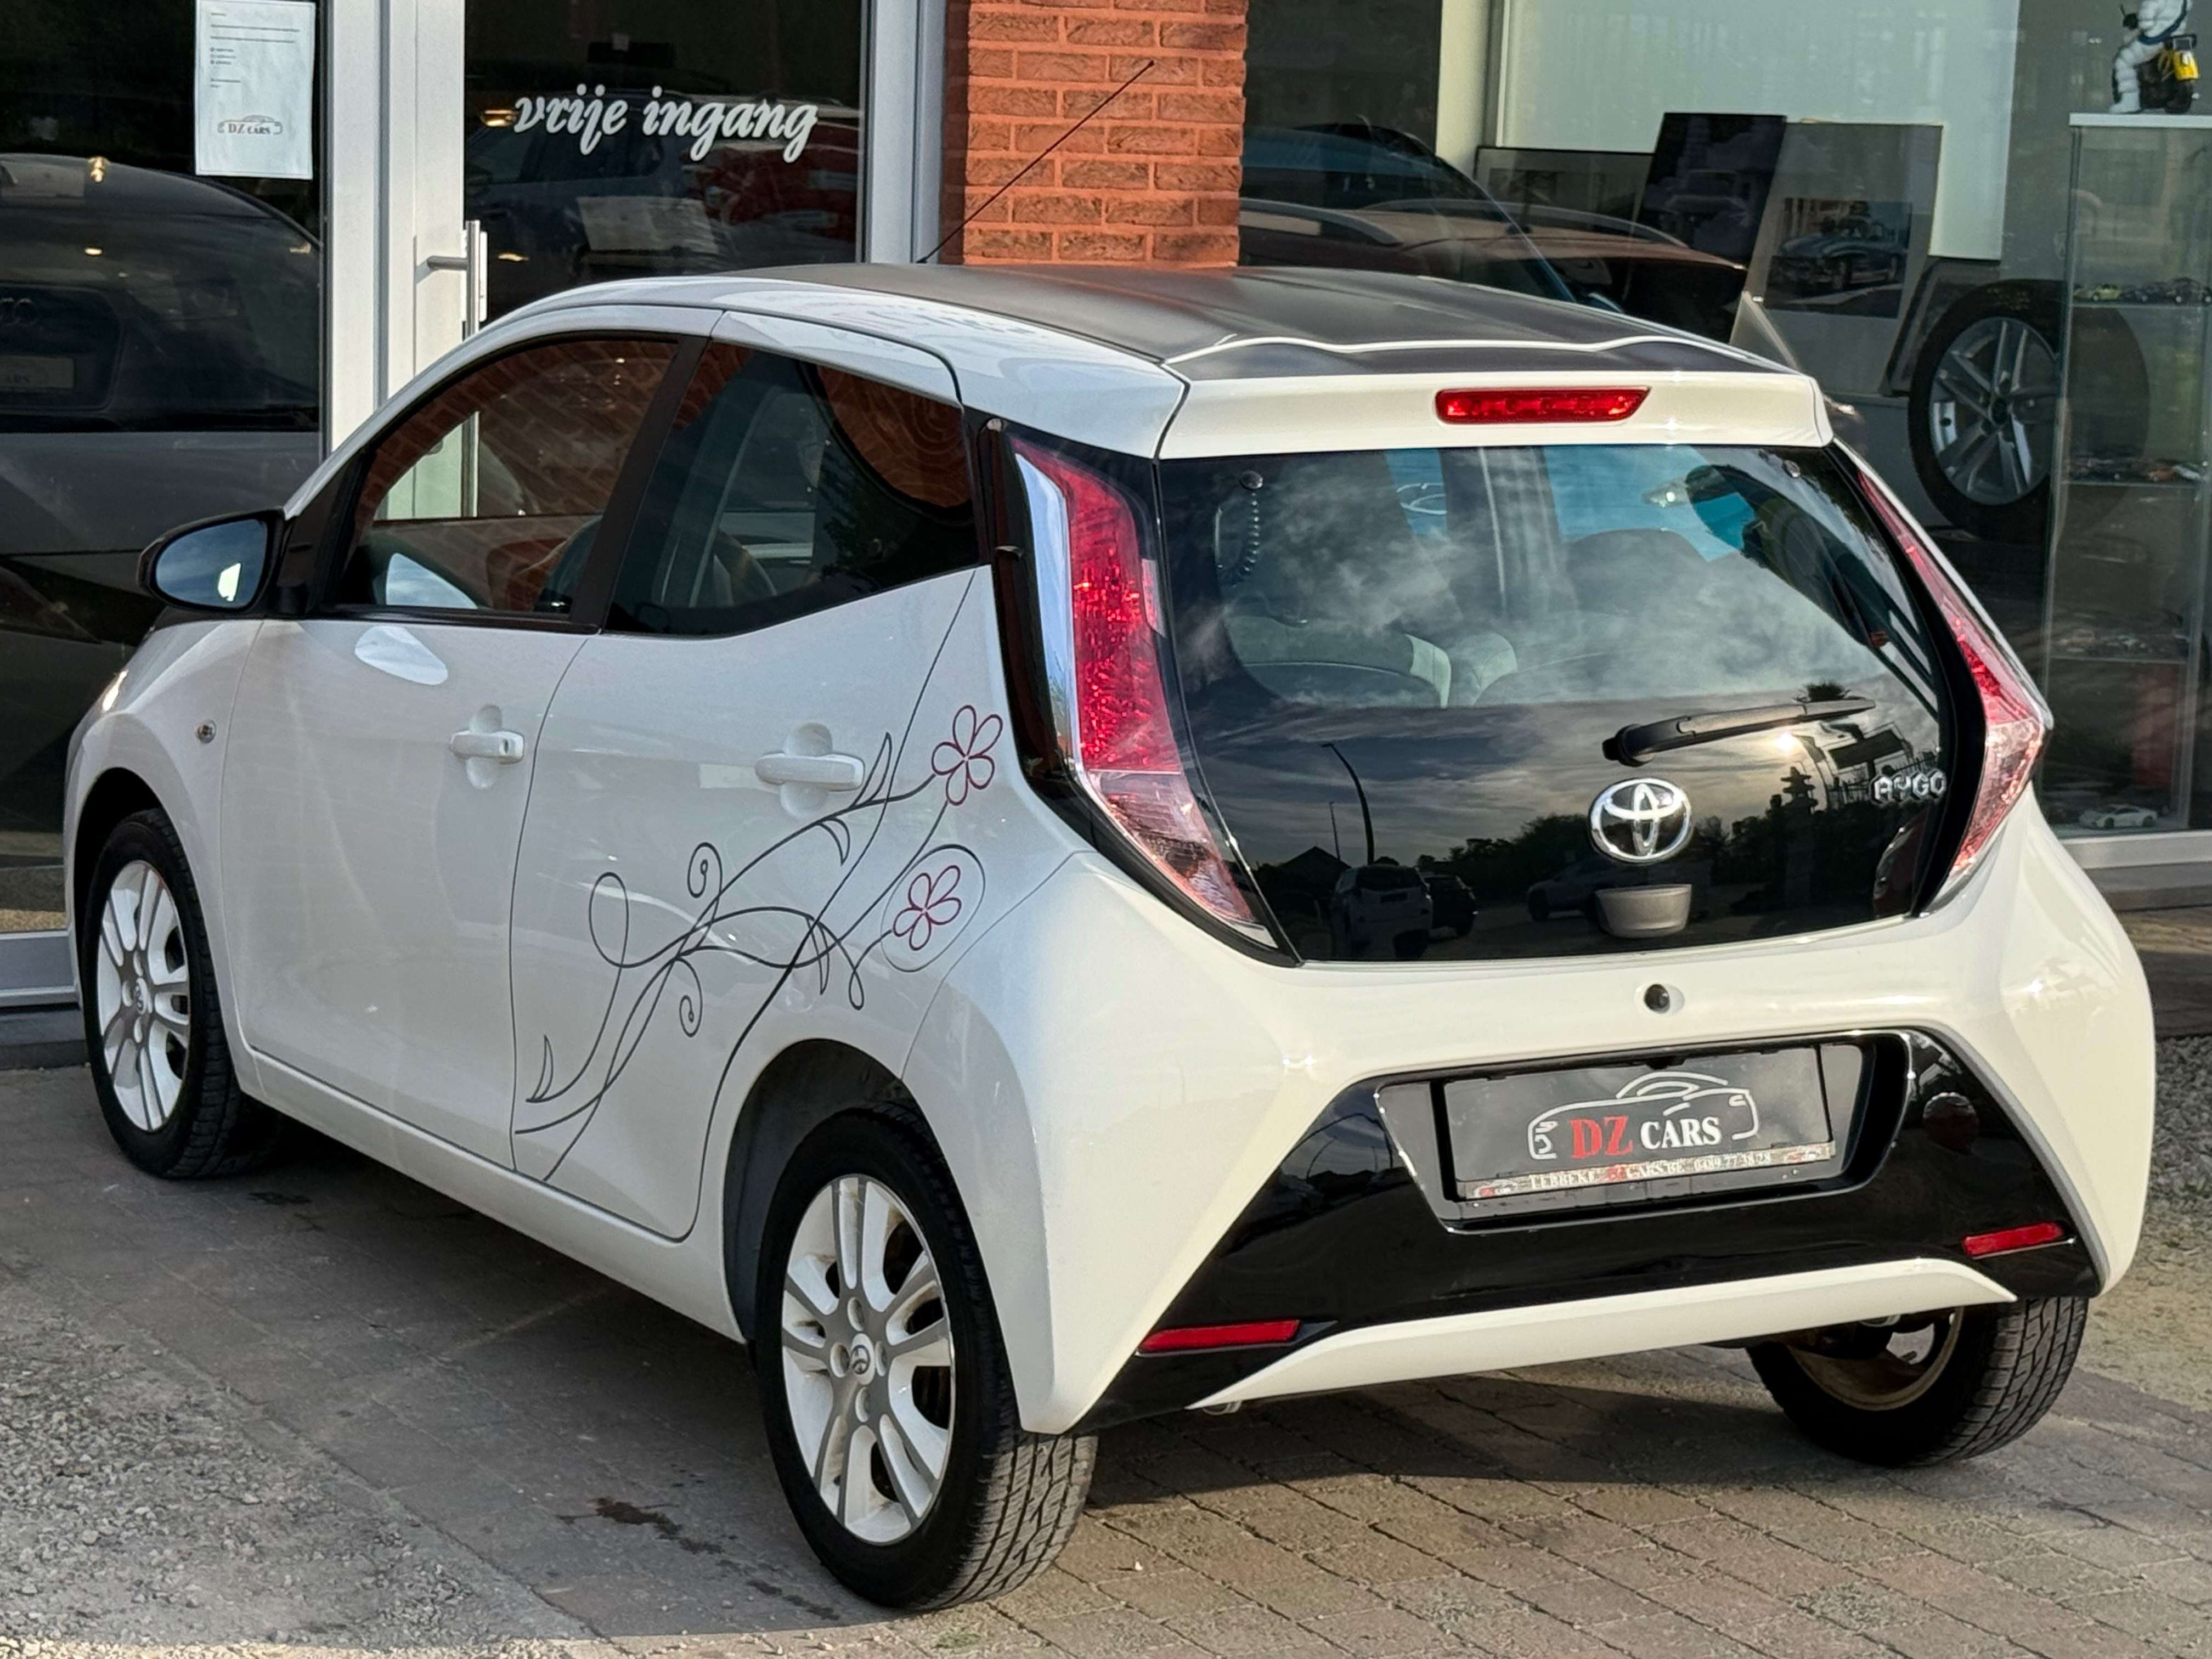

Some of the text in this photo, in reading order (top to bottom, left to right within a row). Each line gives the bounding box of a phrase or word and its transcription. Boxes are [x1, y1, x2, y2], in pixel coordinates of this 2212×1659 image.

[227, 122, 245, 134] DZ
[514, 83, 818, 163] vrije ingang
[1874, 770, 1948, 801] AYGO
[1570, 1115, 1722, 1159] DZ CARS
